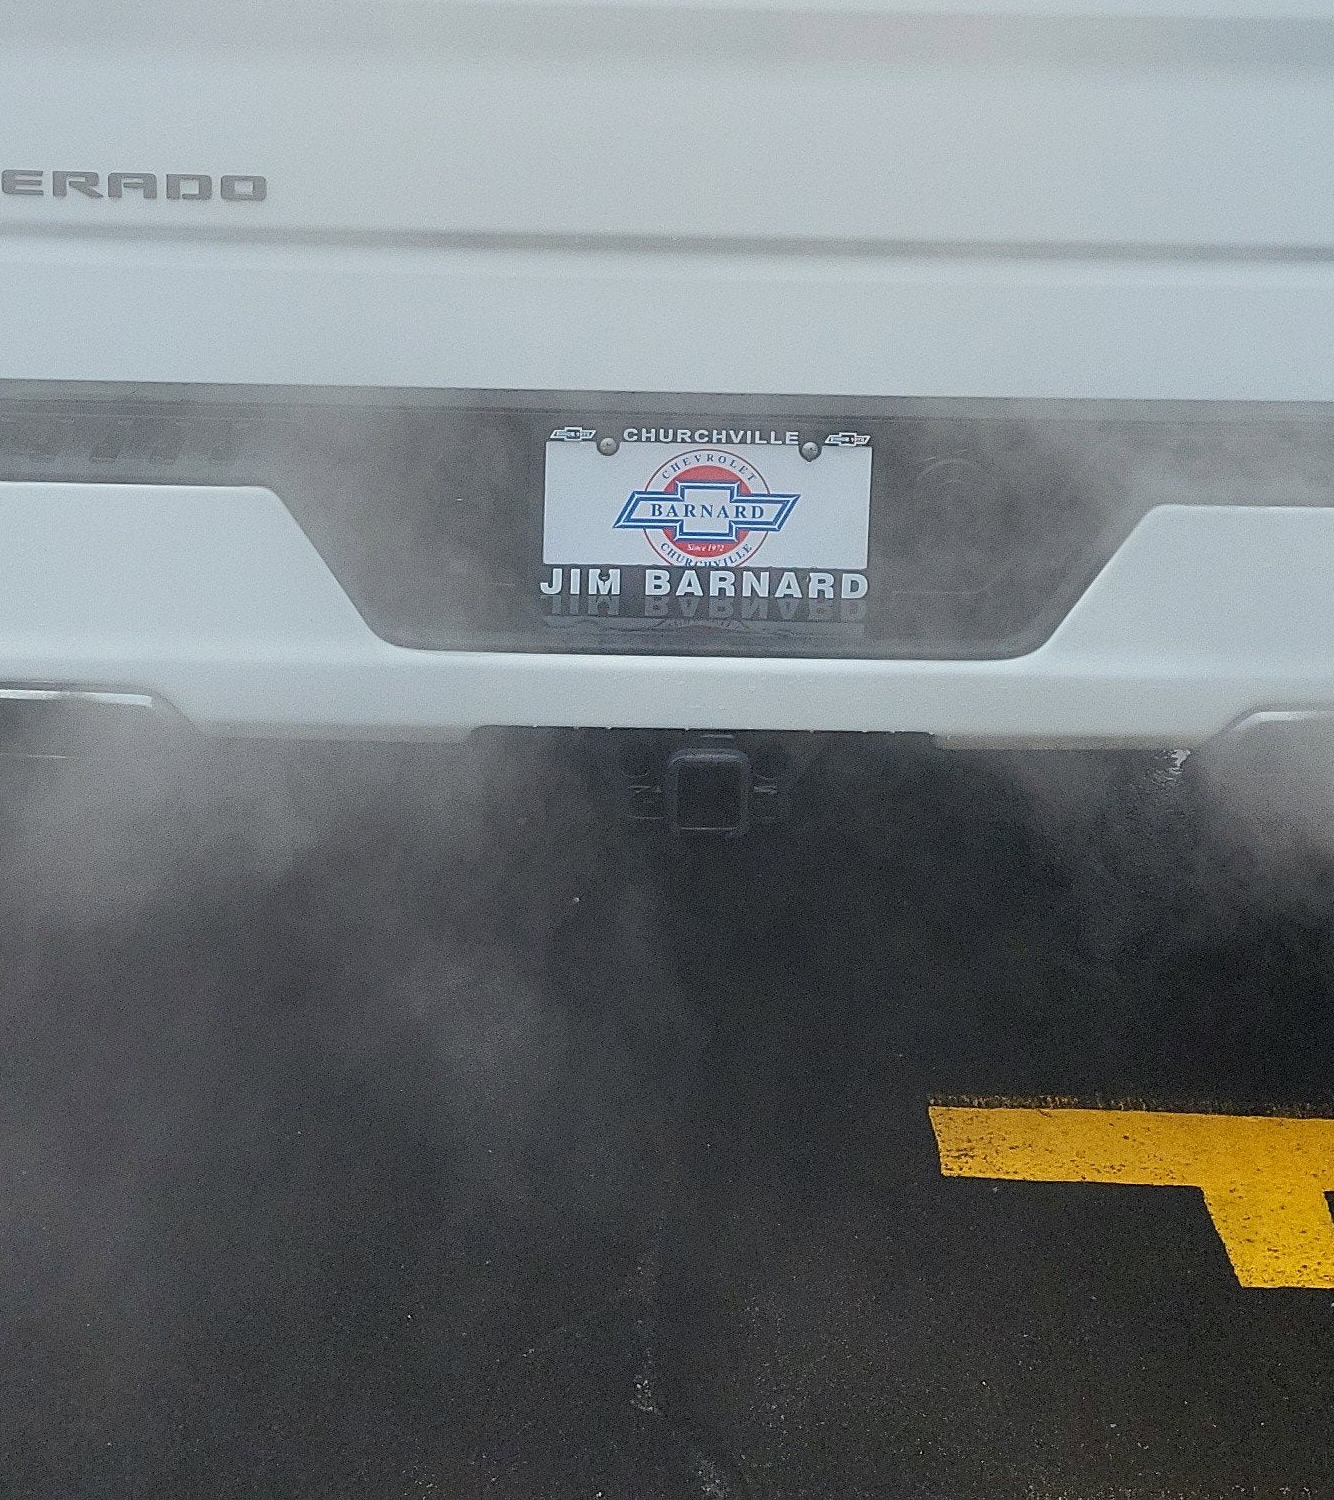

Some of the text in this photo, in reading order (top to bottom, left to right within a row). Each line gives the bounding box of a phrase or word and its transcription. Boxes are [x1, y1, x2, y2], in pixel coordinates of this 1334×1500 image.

[623, 428, 799, 445] CHURCHVILLE
[662, 453, 757, 481] CHEVROLET
[650, 503, 765, 519] BARNARD
[687, 543, 725, 552] Since 1972
[540, 568, 869, 599] JIM BARNARD
